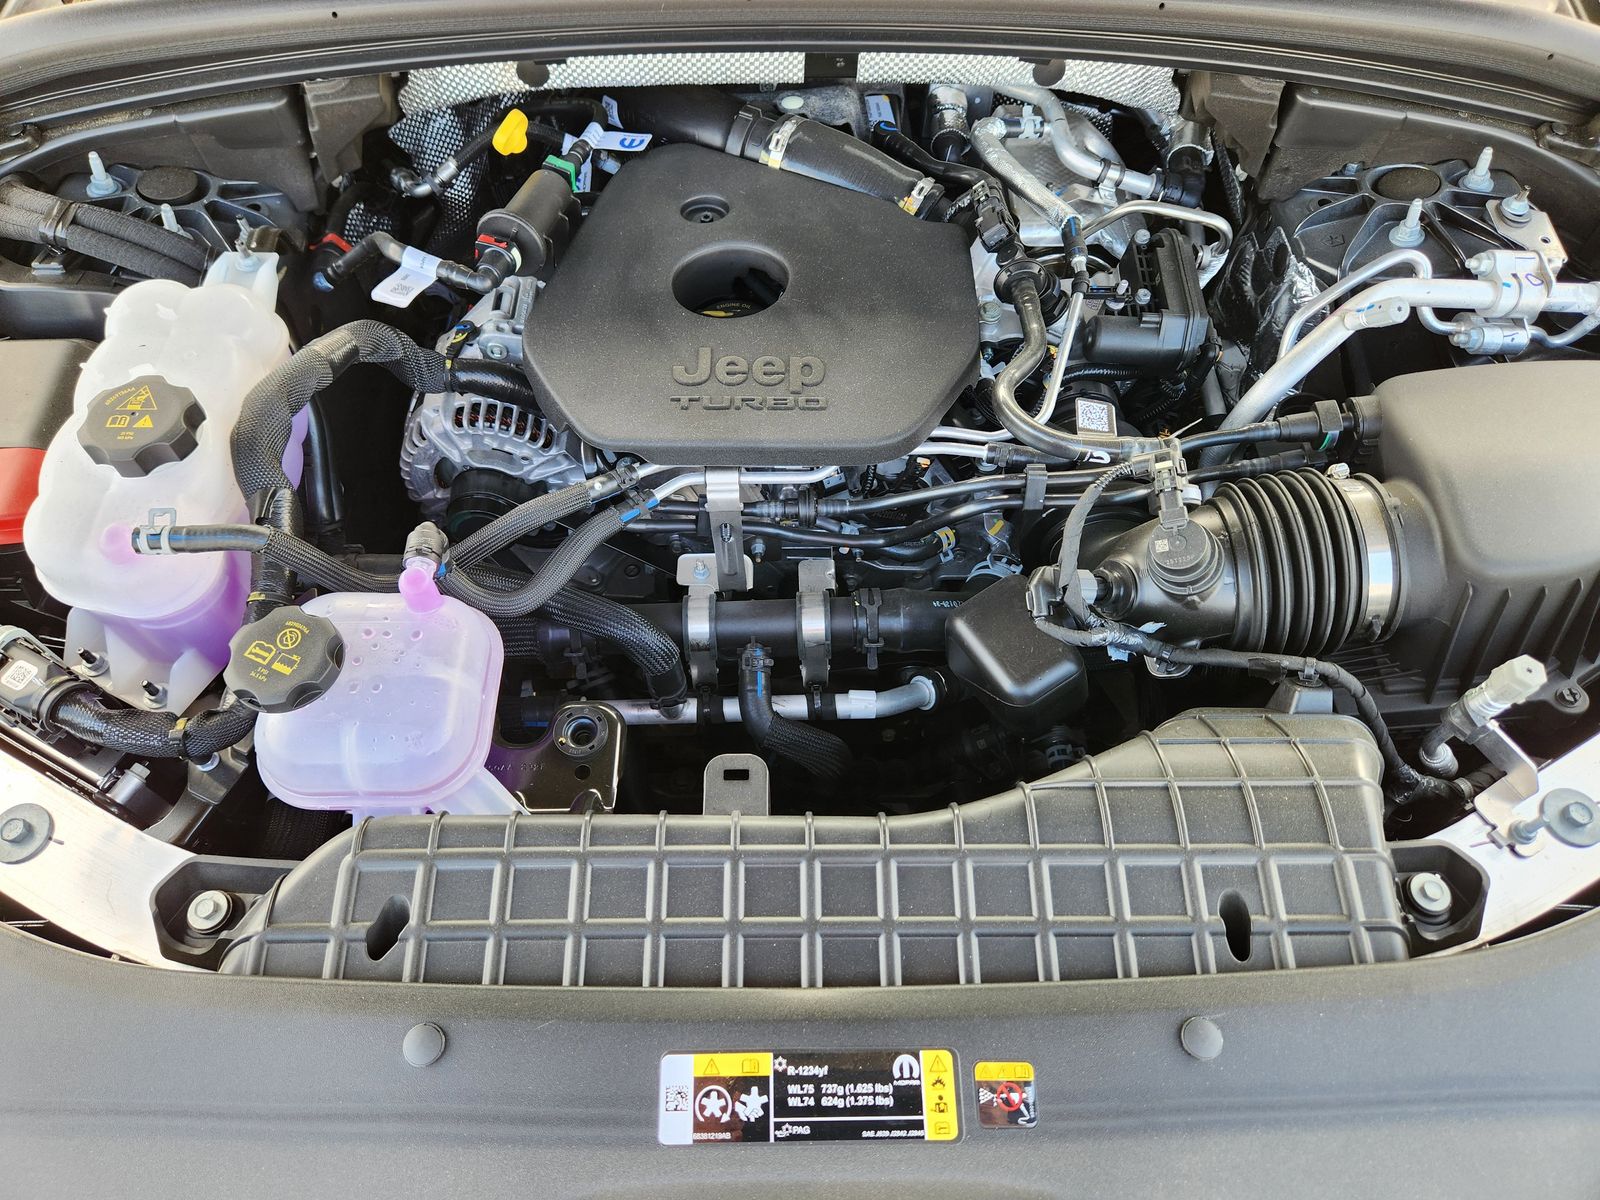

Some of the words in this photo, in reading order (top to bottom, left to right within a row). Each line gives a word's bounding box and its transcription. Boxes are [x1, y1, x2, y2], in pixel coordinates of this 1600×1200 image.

[672, 346, 825, 394] Jeep
[669, 395, 828, 411] TURBO
[787, 1065, 829, 1078] R-1234yf
[787, 1084, 815, 1095] WL75
[821, 1083, 844, 1096] 737g
[845, 1083, 874, 1095] (1.625
[875, 1082, 894, 1095] lbs)
[787, 1096, 815, 1107] WL74
[821, 1096, 845, 1108] 624g
[846, 1096, 874, 1108] (1.375
[875, 1095, 894, 1107] lbs)
[792, 1125, 811, 1135] PAG
